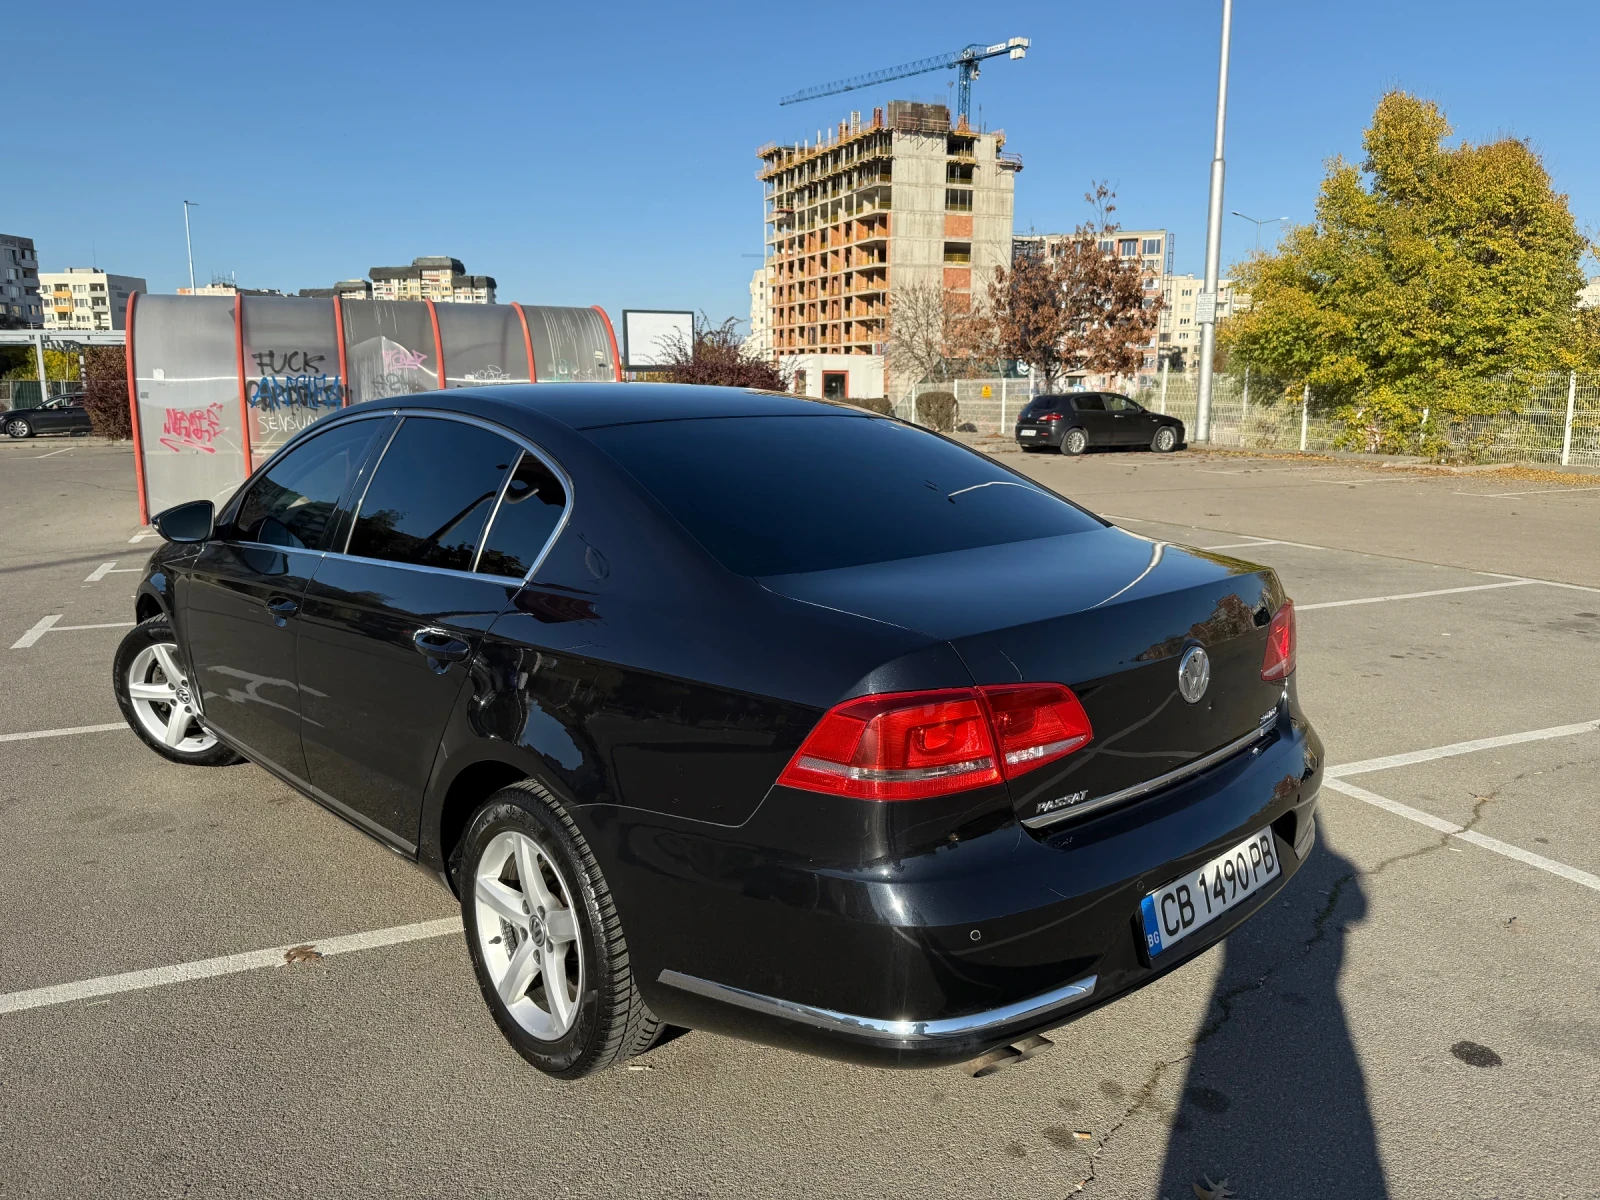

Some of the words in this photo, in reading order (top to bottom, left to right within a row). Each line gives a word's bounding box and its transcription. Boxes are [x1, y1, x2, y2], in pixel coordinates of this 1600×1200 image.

[251, 350, 326, 375] FUCK
[250, 373, 342, 411] ANTIFA
[1035, 789, 1089, 814] PASSAT
[1160, 884, 1196, 937] CB
[1198, 852, 1249, 914] 1490
[1248, 835, 1275, 883] PB
[1147, 931, 1160, 948] BG
